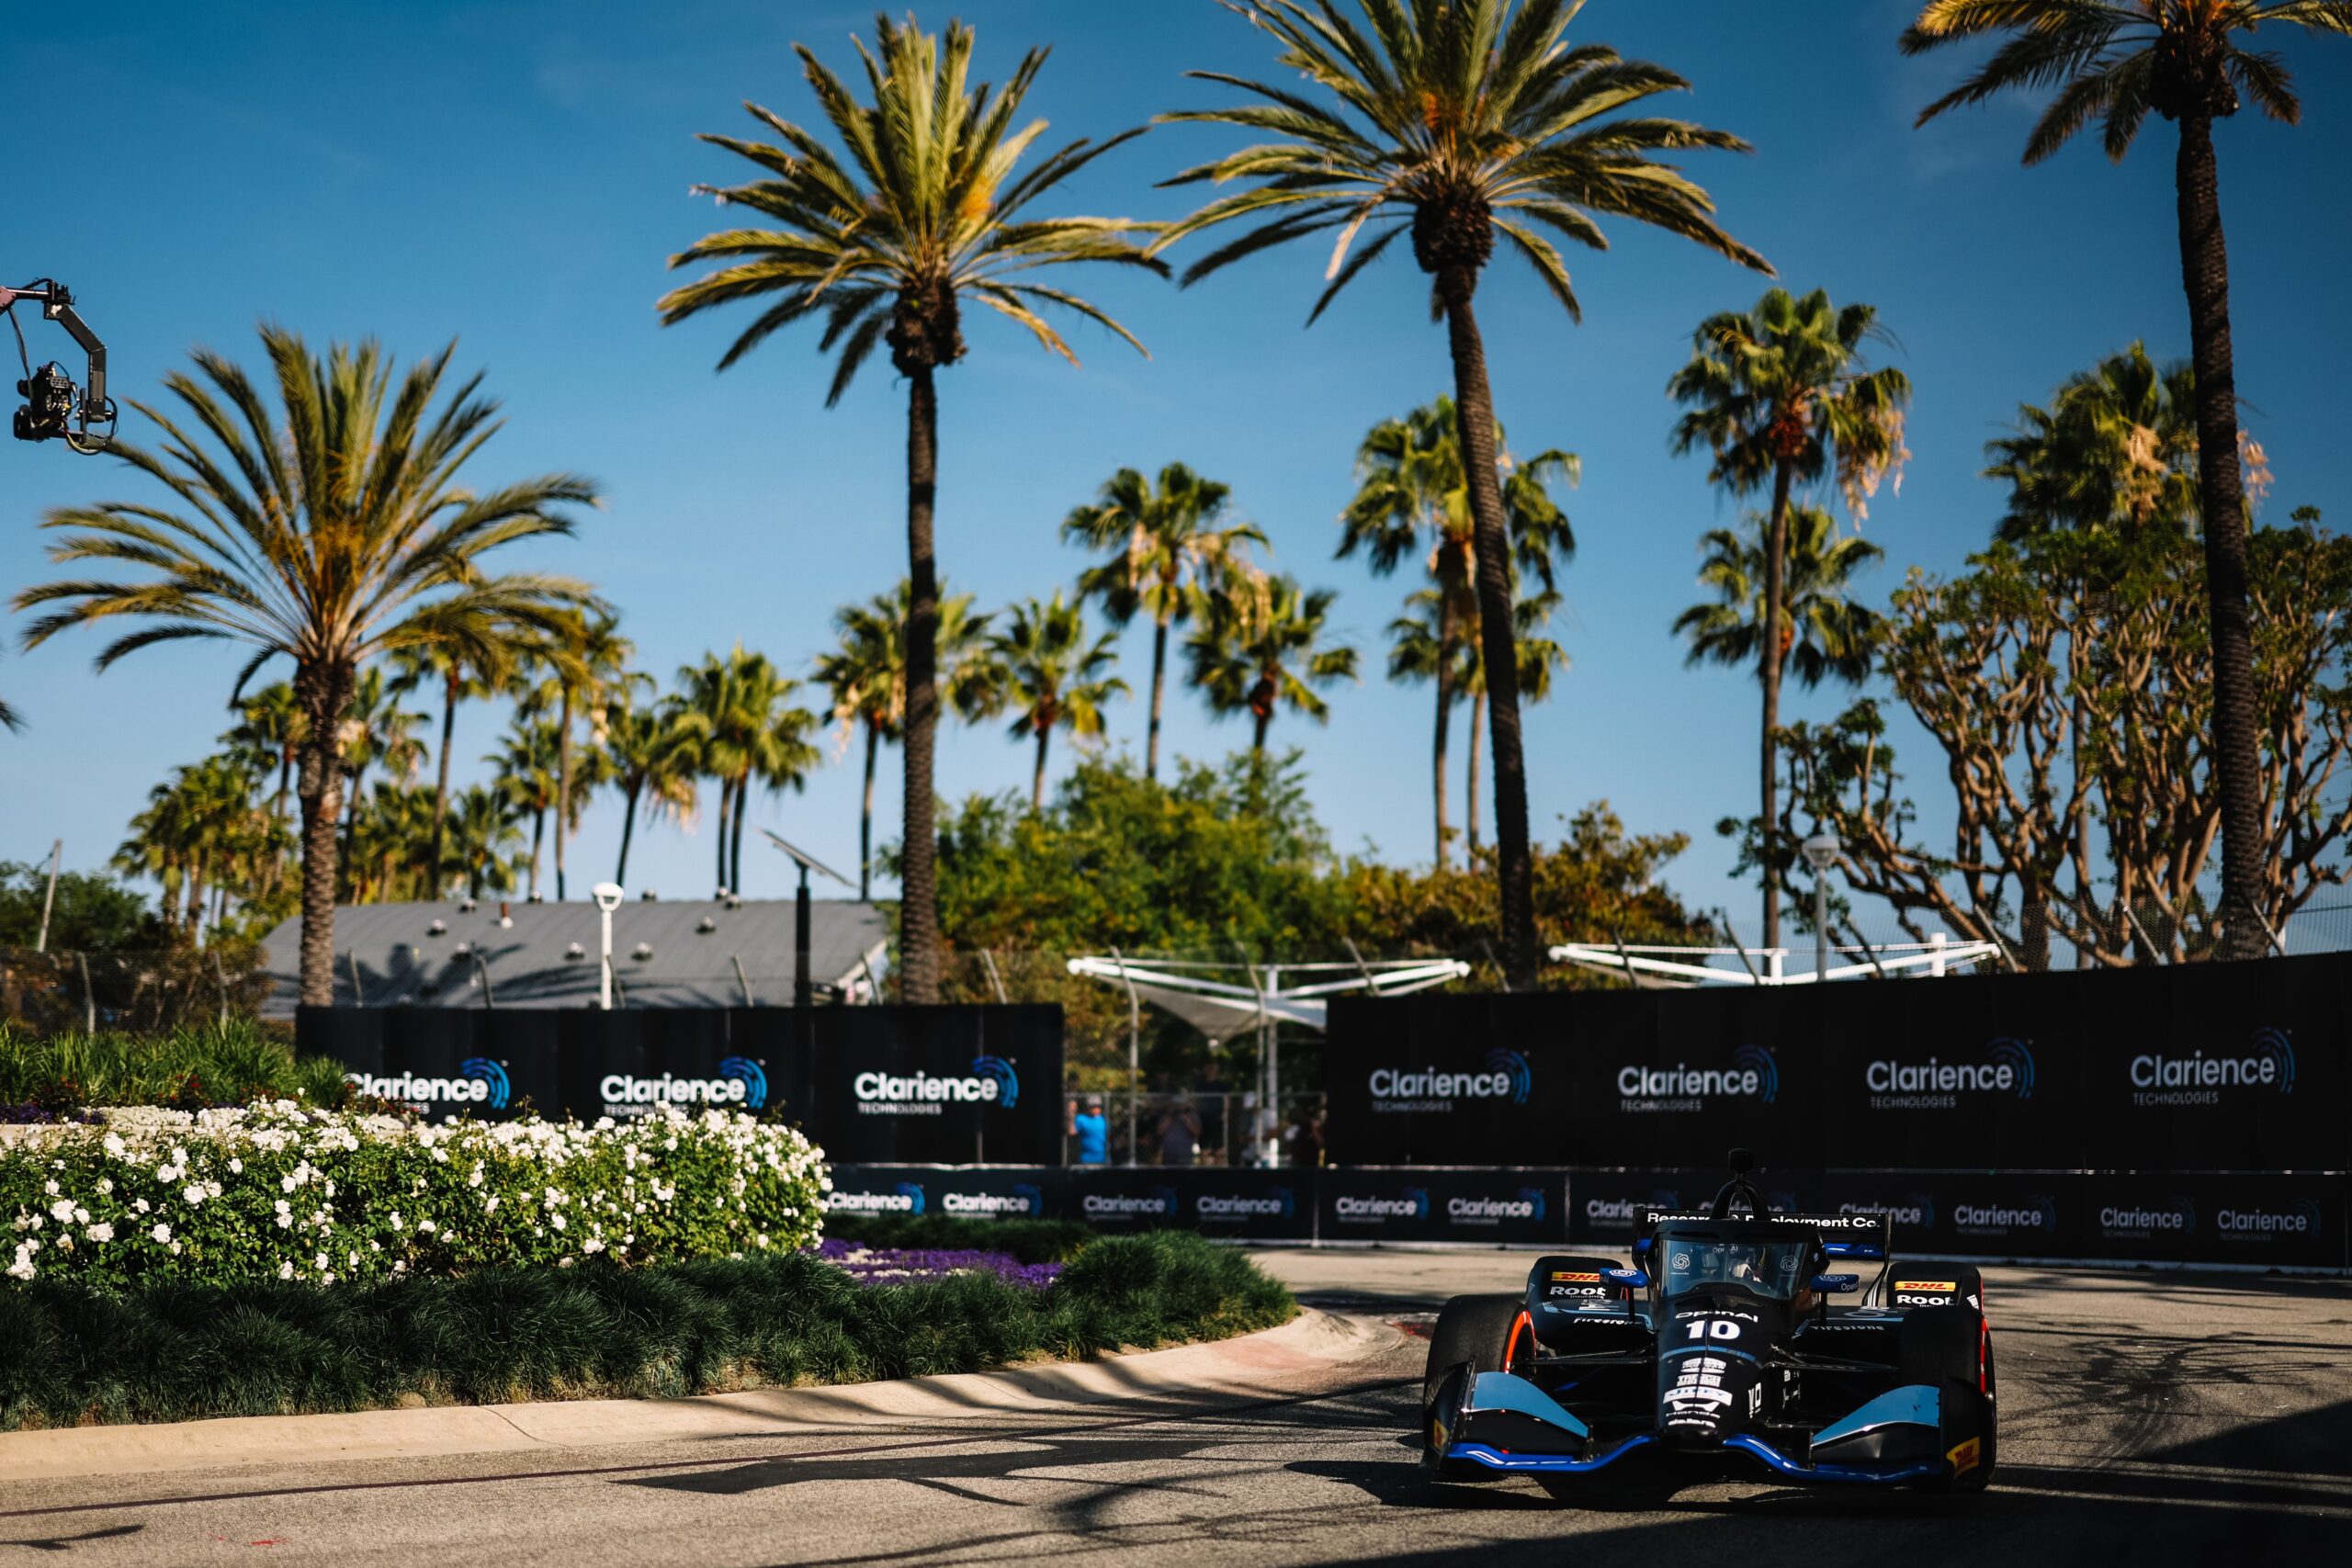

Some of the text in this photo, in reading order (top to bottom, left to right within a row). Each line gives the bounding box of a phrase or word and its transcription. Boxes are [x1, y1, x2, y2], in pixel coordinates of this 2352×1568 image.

[1866, 1057, 2013, 1091] Clarience
[2131, 1050, 2275, 1088] Clarience
[600, 1072, 747, 1102] Clarience
[854, 1070, 998, 1101] Clarience
[1369, 1066, 1510, 1098] Clarience
[1617, 1064, 1759, 1096] Clarience
[1621, 1099, 1702, 1111] TECHNOLOGIES
[1870, 1095, 1956, 1109] TECHNOLOGIES
[2132, 1090, 2219, 1106] TECHNOLOGIES
[857, 1102, 943, 1115] TECHNOLOGIES
[828, 1190, 912, 1211] Clarience
[942, 1191, 1030, 1212] Clarience
[1083, 1194, 1166, 1213] Clarience
[1197, 1195, 1282, 1213] Clarience
[1336, 1196, 1417, 1215] Clarience
[1448, 1197, 1533, 1217] Clarience
[1852, 1216, 1881, 1229] Co.
[1954, 1203, 2042, 1226] Clarience
[2100, 1206, 2183, 1229] Clarience
[2217, 1208, 2308, 1232] Clarience
[1713, 1246, 1738, 1254] OpAI
[1550, 1286, 1606, 1297] Root
[1896, 1294, 1955, 1306] Root
[1686, 1320, 1740, 1340] 10
